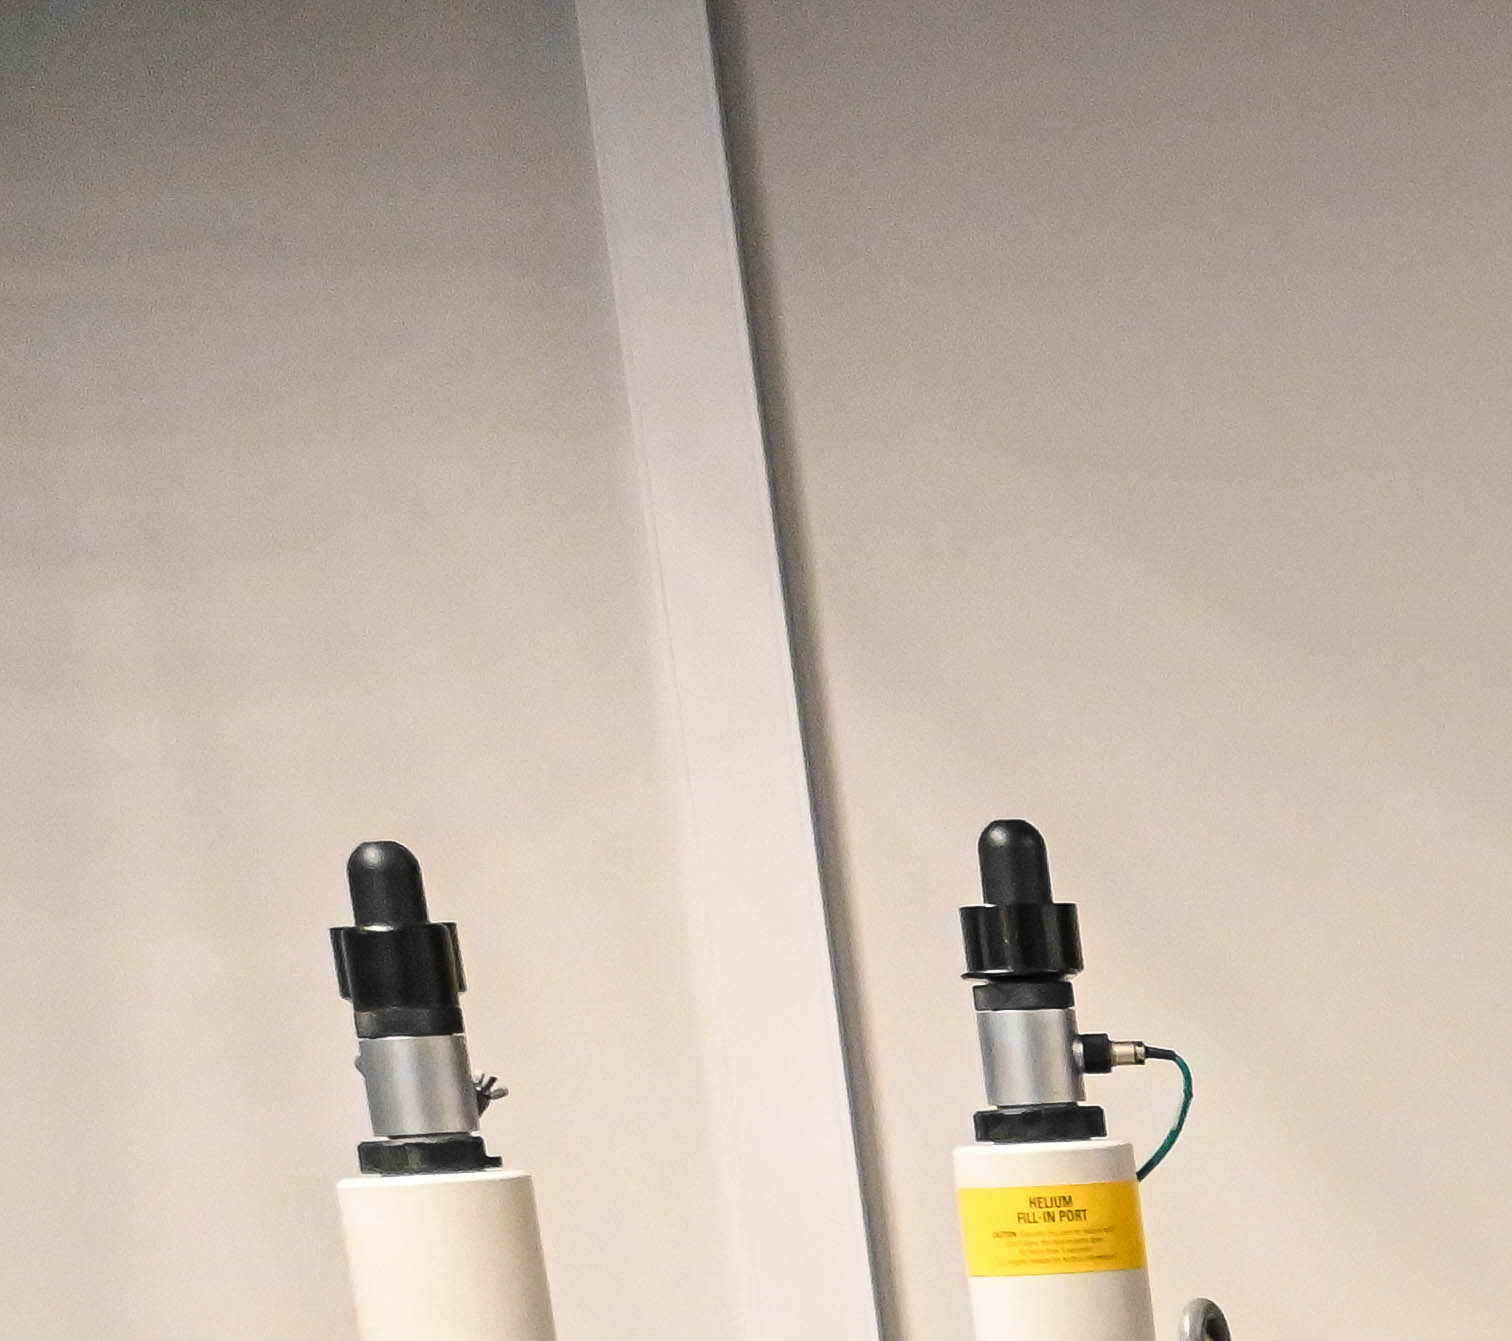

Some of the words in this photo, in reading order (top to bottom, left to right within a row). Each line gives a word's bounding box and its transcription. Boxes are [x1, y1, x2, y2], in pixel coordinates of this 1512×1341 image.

[1029, 1194, 1073, 1209] HELIUM
[1016, 1210, 1056, 1224] FILL-IN
[1058, 1208, 1088, 1223] PORT
